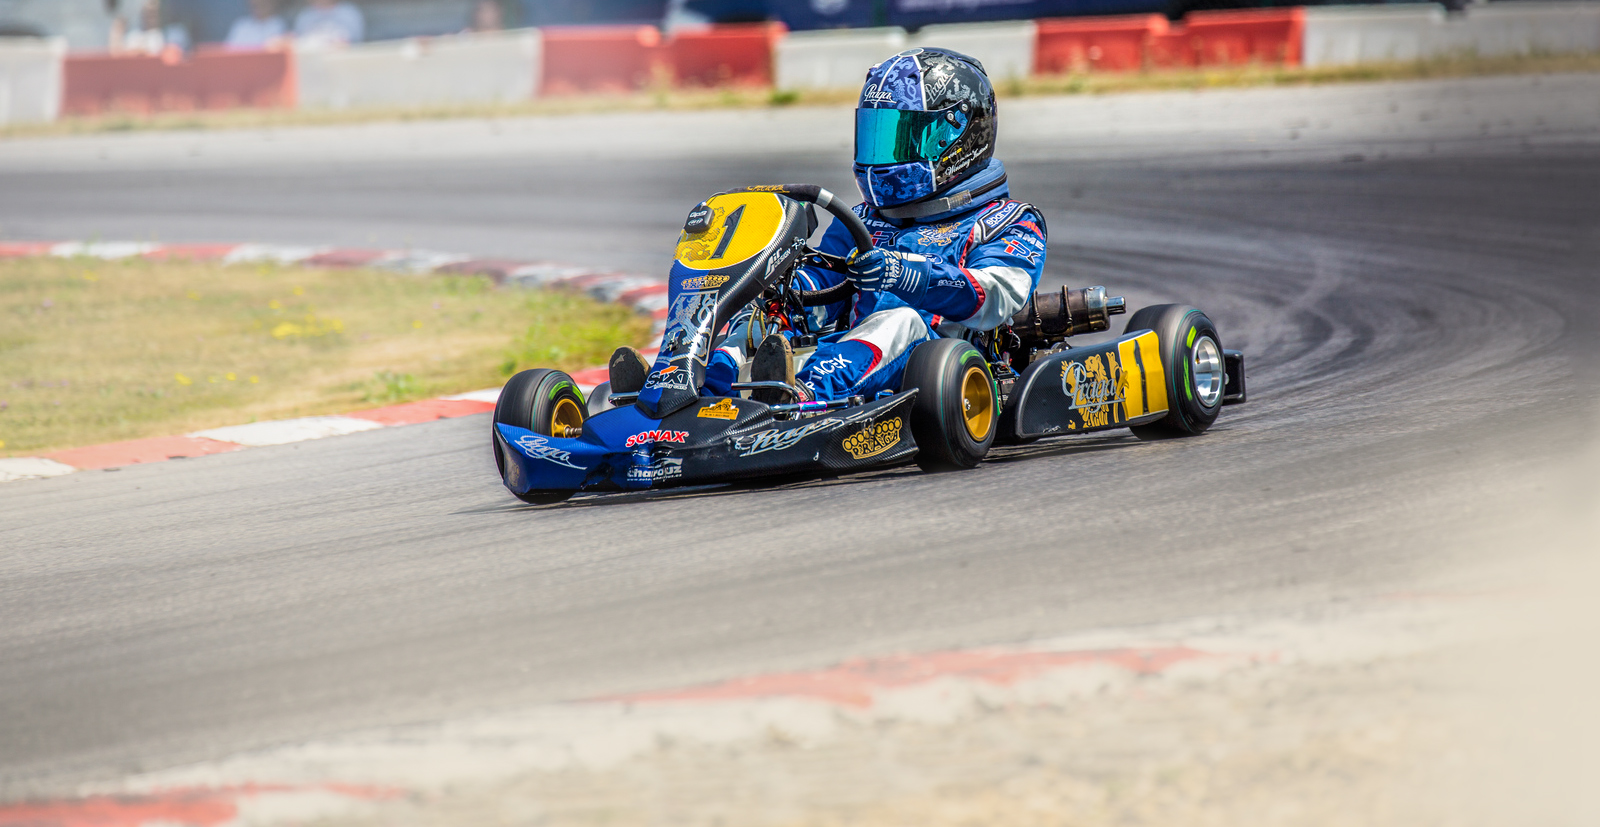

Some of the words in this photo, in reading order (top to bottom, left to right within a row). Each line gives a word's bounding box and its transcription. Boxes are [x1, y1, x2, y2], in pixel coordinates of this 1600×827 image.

[708, 204, 747, 260] 1
[985, 202, 1019, 228] sparco
[1062, 362, 1126, 414] Praga
[625, 430, 690, 447] SONAX
